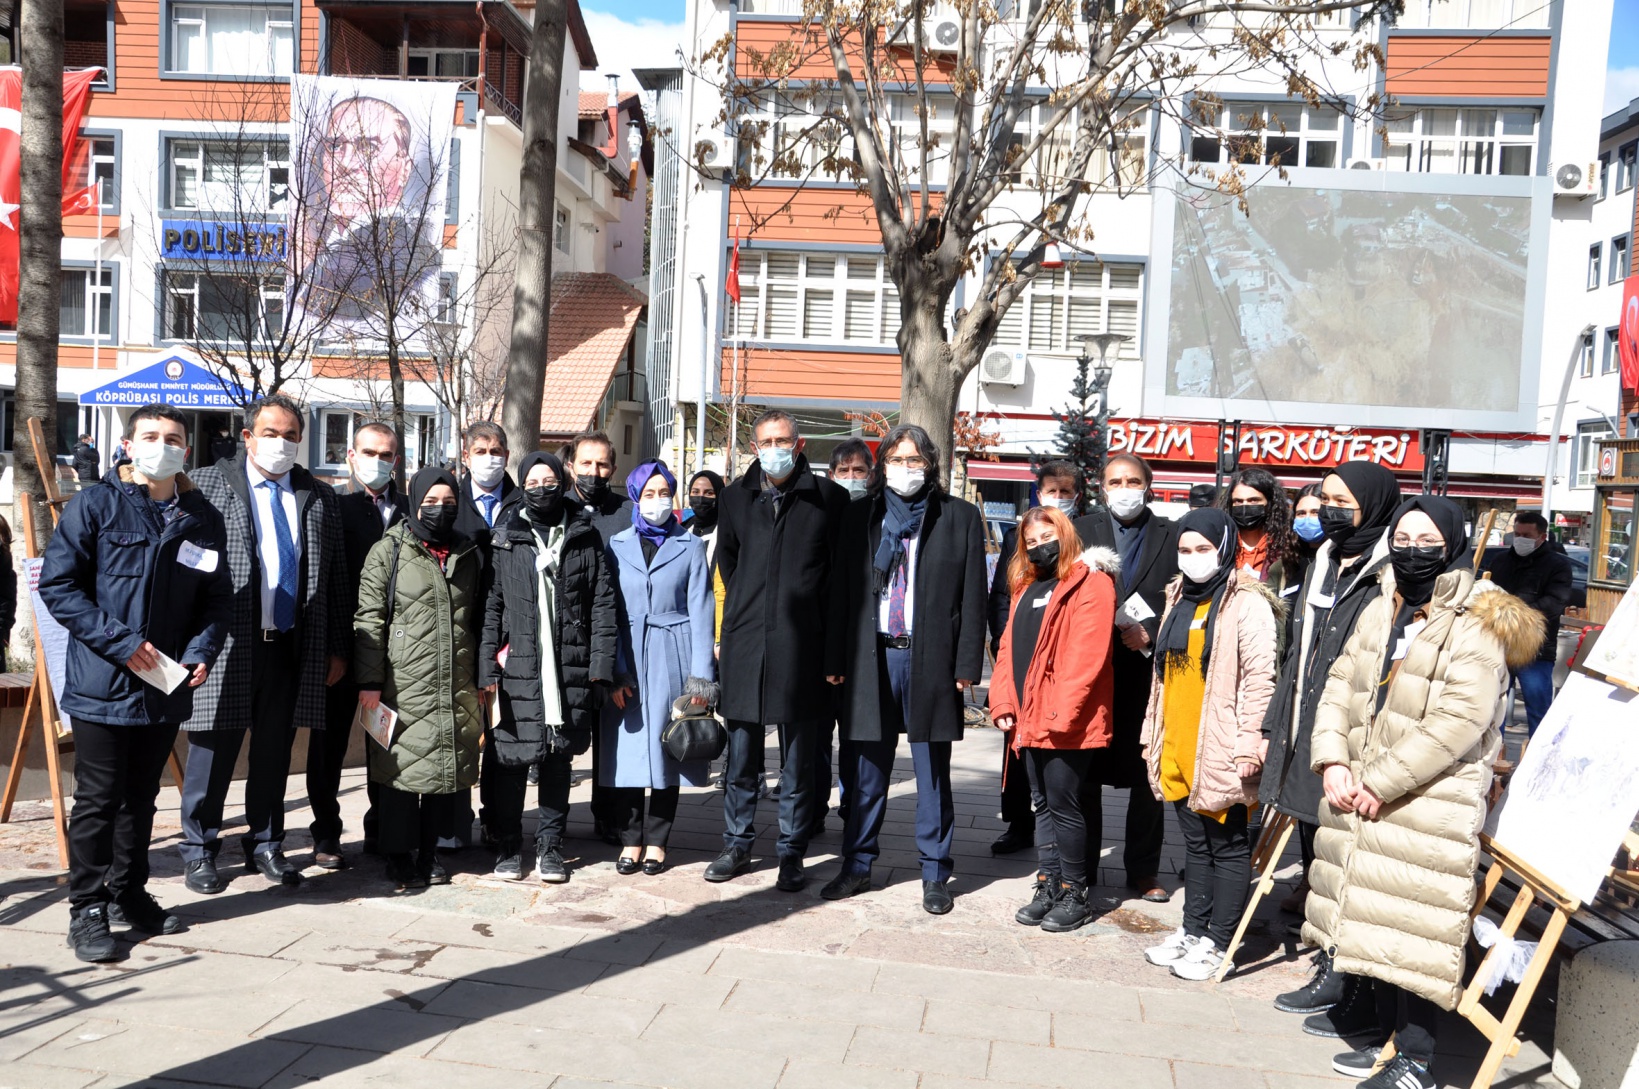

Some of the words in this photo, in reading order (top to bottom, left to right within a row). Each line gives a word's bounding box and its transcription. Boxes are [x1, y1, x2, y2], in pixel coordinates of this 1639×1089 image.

[118, 381, 158, 390] GÜMÜŞHANE
[161, 382, 188, 390] EMNİYET
[95, 390, 161, 404] KÖPRÜBAŞI
[165, 391, 199, 405] POLİS
[1107, 422, 1194, 456] BİZİM
